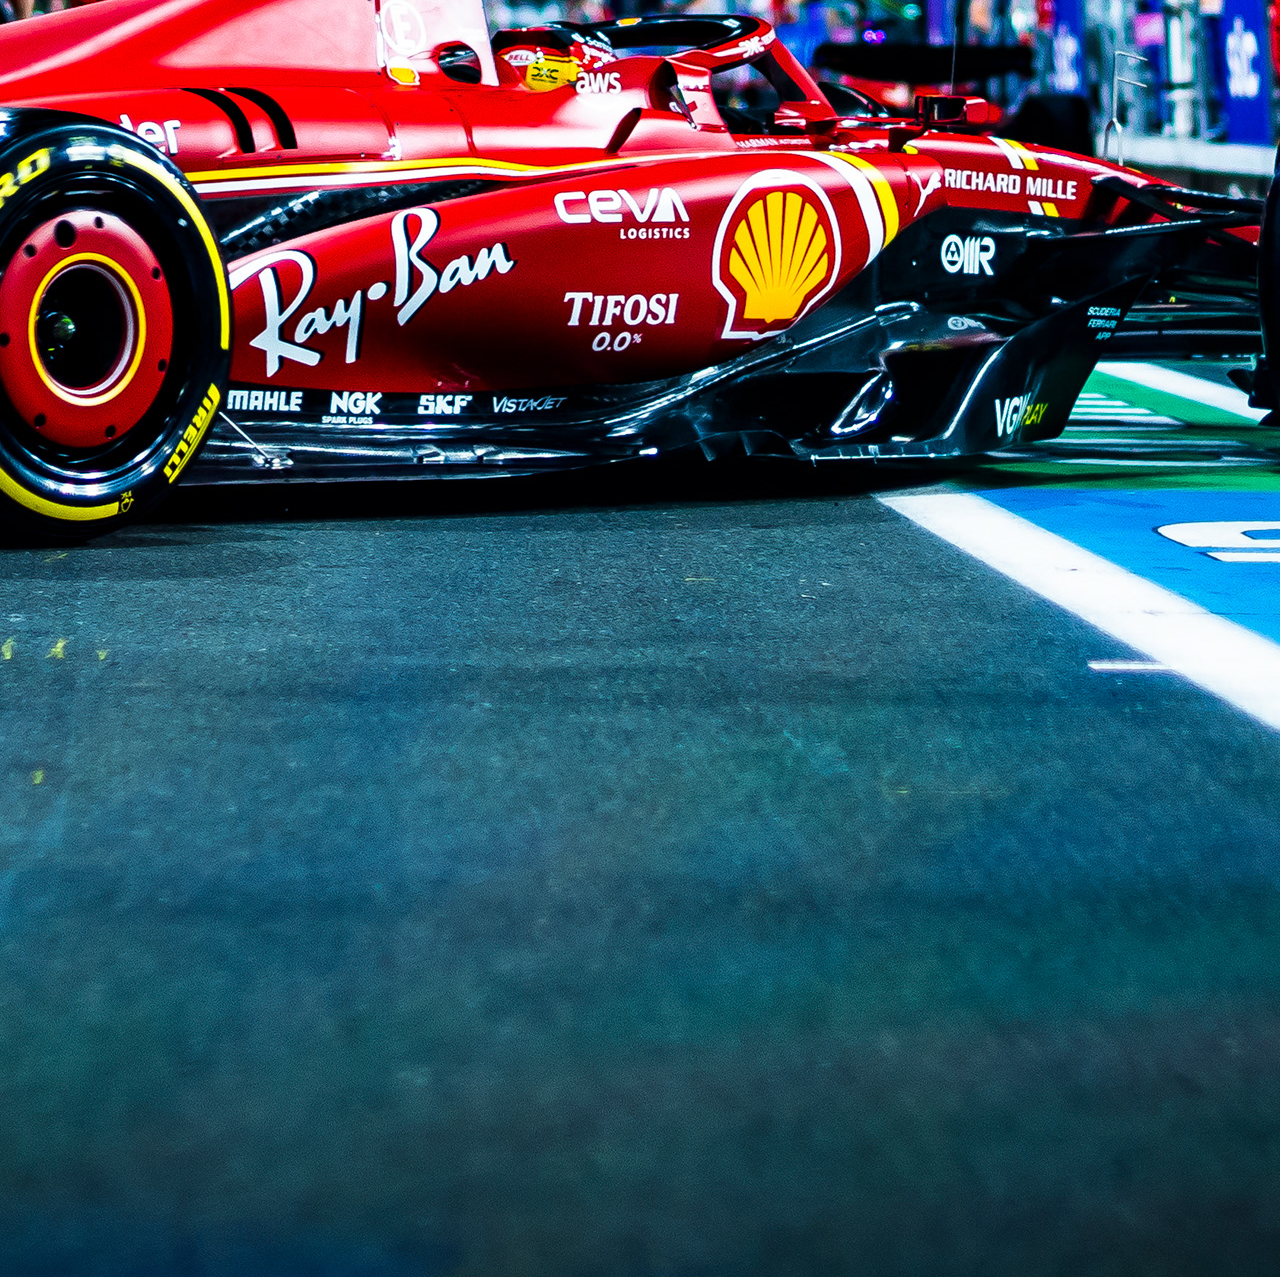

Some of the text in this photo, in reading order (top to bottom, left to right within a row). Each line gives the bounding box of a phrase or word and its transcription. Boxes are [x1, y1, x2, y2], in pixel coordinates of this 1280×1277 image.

[507, 54, 531, 62] BELL
[575, 71, 622, 94] aws
[943, 168, 1078, 200] RICHARD MILLE
[619, 227, 690, 240] LOGISTICS
[563, 291, 680, 327] TIFOSI
[1087, 306, 1121, 317] SCUDERIA
[1087, 318, 1118, 329] FERRARI
[591, 331, 644, 352] 0.0%
[1095, 331, 1112, 341] APP
[227, 389, 304, 413] MAHLE
[330, 390, 383, 416] NGK
[417, 394, 474, 416] SKF
[321, 413, 374, 426] SPARK PLUGS
[1020, 402, 1049, 426] PLAY
[162, 382, 221, 485] PIRELLI
